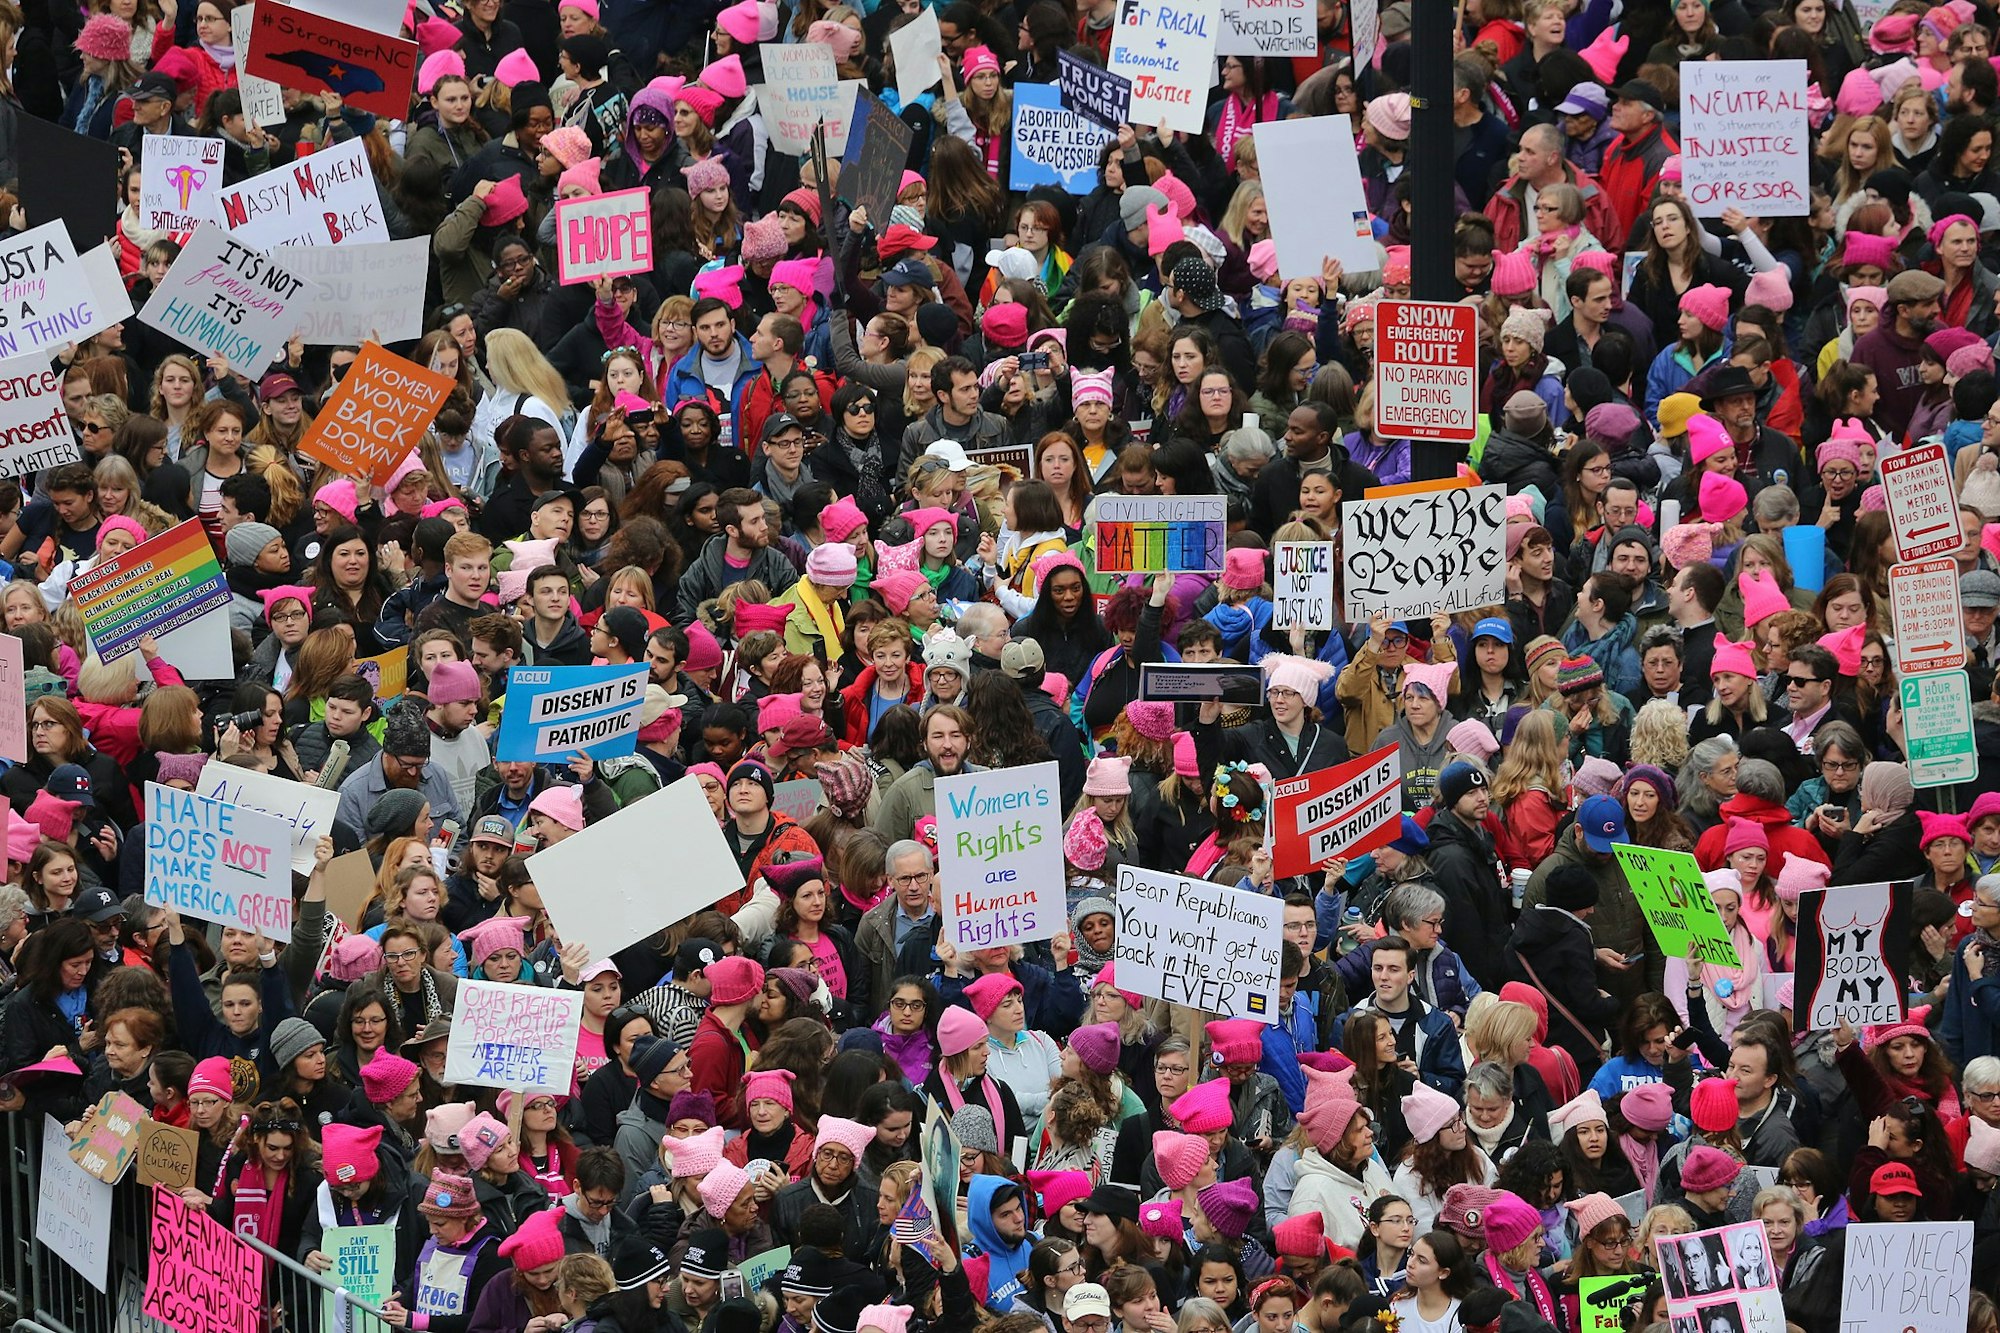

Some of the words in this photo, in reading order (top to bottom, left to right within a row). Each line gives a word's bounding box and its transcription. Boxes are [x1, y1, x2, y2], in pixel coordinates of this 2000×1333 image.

[1156, 6, 1207, 38] RACIAL
[1232, 19, 1283, 36] WORLD
[1288, 17, 1302, 34] IS
[1254, 35, 1316, 52] WATCHING
[766, 66, 804, 80] PLACE
[1114, 47, 1180, 72] ECONOMIC
[787, 85, 840, 101] HOUSE
[1058, 59, 1128, 106] TRUST
[1133, 75, 1191, 105] JUSTICE
[1059, 77, 1127, 123] WOMEN
[1690, 90, 1806, 116] NEUTRAL
[1019, 109, 1083, 129] ABORTION:
[1684, 135, 1799, 159] INJUSTICE
[293, 154, 364, 203] WOMEN
[1691, 181, 1803, 204] OPRESSOR
[143, 192, 162, 208] YOUR
[221, 182, 292, 231] NASTY
[323, 203, 378, 245] BACK
[568, 210, 648, 264] HOPE
[217, 239, 265, 281] IT'S
[260, 265, 304, 300] NOT
[183, 263, 285, 320] feminism
[207, 293, 247, 325] IT'S
[1397, 305, 1455, 327] SNOW
[21, 302, 94, 346] THING
[159, 296, 263, 369] HUMANISM
[1387, 326, 1465, 343] EMERGENCY
[1394, 342, 1458, 364] ROUTE
[364, 357, 441, 405] WOMEN
[1385, 367, 1405, 383] NO
[1410, 368, 1468, 386] PARKING
[353, 377, 429, 423] WON'T
[1401, 387, 1451, 405] DURING
[335, 398, 414, 447] BACK
[1385, 405, 1467, 425] EMERGENCY
[321, 421, 399, 466] DOWN
[990, 451, 1025, 463] PERFECT
[12, 442, 79, 475] MATTER
[1887, 457, 1906, 471] TOW
[1910, 448, 1936, 464] AWAY
[1891, 474, 1902, 486] NO
[1905, 463, 1940, 481] PARKING
[1903, 475, 1945, 497] STANDING
[1099, 501, 1152, 521] CIVIL
[1157, 501, 1224, 521] RIGHTS
[1899, 511, 1919, 526] BUS
[1923, 502, 1949, 519] ZONE
[1907, 492, 1937, 510] METRO
[1100, 527, 1221, 570] MATTER
[1280, 546, 1328, 576] JUSTICE
[1911, 545, 1932, 559] TOWED
[1932, 540, 1948, 552] CALL
[72, 574, 91, 591] LOVE
[101, 562, 119, 577] LOVE
[1348, 537, 1503, 600] People
[1896, 566, 1919, 576] TOW
[1922, 562, 1949, 573] AWAY
[78, 588, 102, 605] BLACK
[102, 577, 122, 592] LIVES
[124, 562, 152, 582] MATTER
[84, 599, 115, 619] CLIMATE
[116, 584, 144, 603] CHANGE
[155, 569, 174, 584] REAL
[1291, 575, 1312, 593] NOT
[1897, 581, 1909, 593] NO
[1912, 575, 1952, 591] STANDING
[1900, 595, 1912, 606] OR
[1915, 589, 1953, 605] PARKING
[90, 610, 127, 632] RELIGIOUS
[127, 592, 160, 614] FREEDOM
[161, 585, 176, 597] FOR
[96, 619, 142, 647] IMMIGRANTS
[142, 607, 162, 623] MAKE
[163, 592, 194, 613] AMERICA
[194, 580, 217, 598] GREAT
[1308, 597, 1323, 626] US
[1901, 604, 1953, 620] 7AM-9:30AM
[1902, 617, 1956, 633] 4PM-6:30PM
[515, 672, 549, 683] ACLU
[541, 684, 615, 716] DISSENT
[620, 679, 637, 699] IS
[1904, 682, 1917, 703] 2
[1924, 682, 1951, 695] HOUR
[1925, 692, 1961, 705] PARKING
[548, 712, 632, 747] PATRIOTIC
[948, 784, 1049, 819] Women's
[1275, 780, 1308, 797] ACLU
[1307, 774, 1371, 824] DISSENT
[1377, 762, 1391, 786] IS
[155, 787, 236, 836] HATE
[1320, 796, 1393, 853] PATRIOTIC
[149, 823, 218, 861] DOES
[221, 838, 271, 872] NOT
[956, 820, 1043, 862] Rights
[150, 853, 212, 884] MAKE
[985, 869, 1017, 884] are
[1626, 852, 1652, 873] FOR
[146, 876, 238, 916] AMERICA
[238, 893, 291, 930] GREAT
[955, 890, 1038, 917] Human
[1119, 871, 1169, 903] Dear
[1176, 882, 1269, 930] Republicans,
[1656, 875, 1716, 914] LOVE
[958, 909, 1036, 946] Rights
[1118, 904, 1158, 941] You
[1169, 926, 1218, 955] won't
[1223, 936, 1258, 963] get
[1262, 949, 1280, 966] us
[1648, 909, 1689, 932] AGAINST
[1692, 933, 1742, 967] HATE
[1827, 928, 1872, 956] MY
[1116, 937, 1156, 969] back
[1163, 953, 1176, 972] in
[1183, 953, 1210, 979] the
[1826, 955, 1881, 979] BODY
[463, 986, 506, 1011] OUR
[511, 992, 572, 1020] RIGHTS
[1161, 973, 1239, 1017] EVER.
[1836, 975, 1885, 1004] MY
[462, 1007, 500, 1029] ARE
[506, 1013, 541, 1032] NOT
[543, 1018, 567, 1034] UP
[1816, 1004, 1897, 1027] CHOICE
[473, 1026, 507, 1044] FOR
[508, 1029, 564, 1050] GRABS
[472, 1043, 542, 1066] NEITHER
[476, 1061, 515, 1081] ARE
[519, 1065, 548, 1085] WE
[152, 1136, 180, 1156] RAPE
[145, 1154, 190, 1176] CULTURE
[154, 1186, 212, 1250] EVEN
[214, 1223, 256, 1290] WITH
[339, 1245, 366, 1256] BELIEVE
[368, 1245, 380, 1255] WE
[1850, 1233, 1895, 1268] MY
[1904, 1229, 1973, 1276] NECK
[152, 1223, 212, 1275] SMALL
[211, 1254, 261, 1311] HANDS
[152, 1251, 186, 1296] YOU
[338, 1255, 379, 1276] STILL
[343, 1275, 364, 1285] HAVE
[365, 1275, 374, 1284] TO
[1846, 1271, 1894, 1313] MY
[1899, 1271, 1966, 1317] BACK
